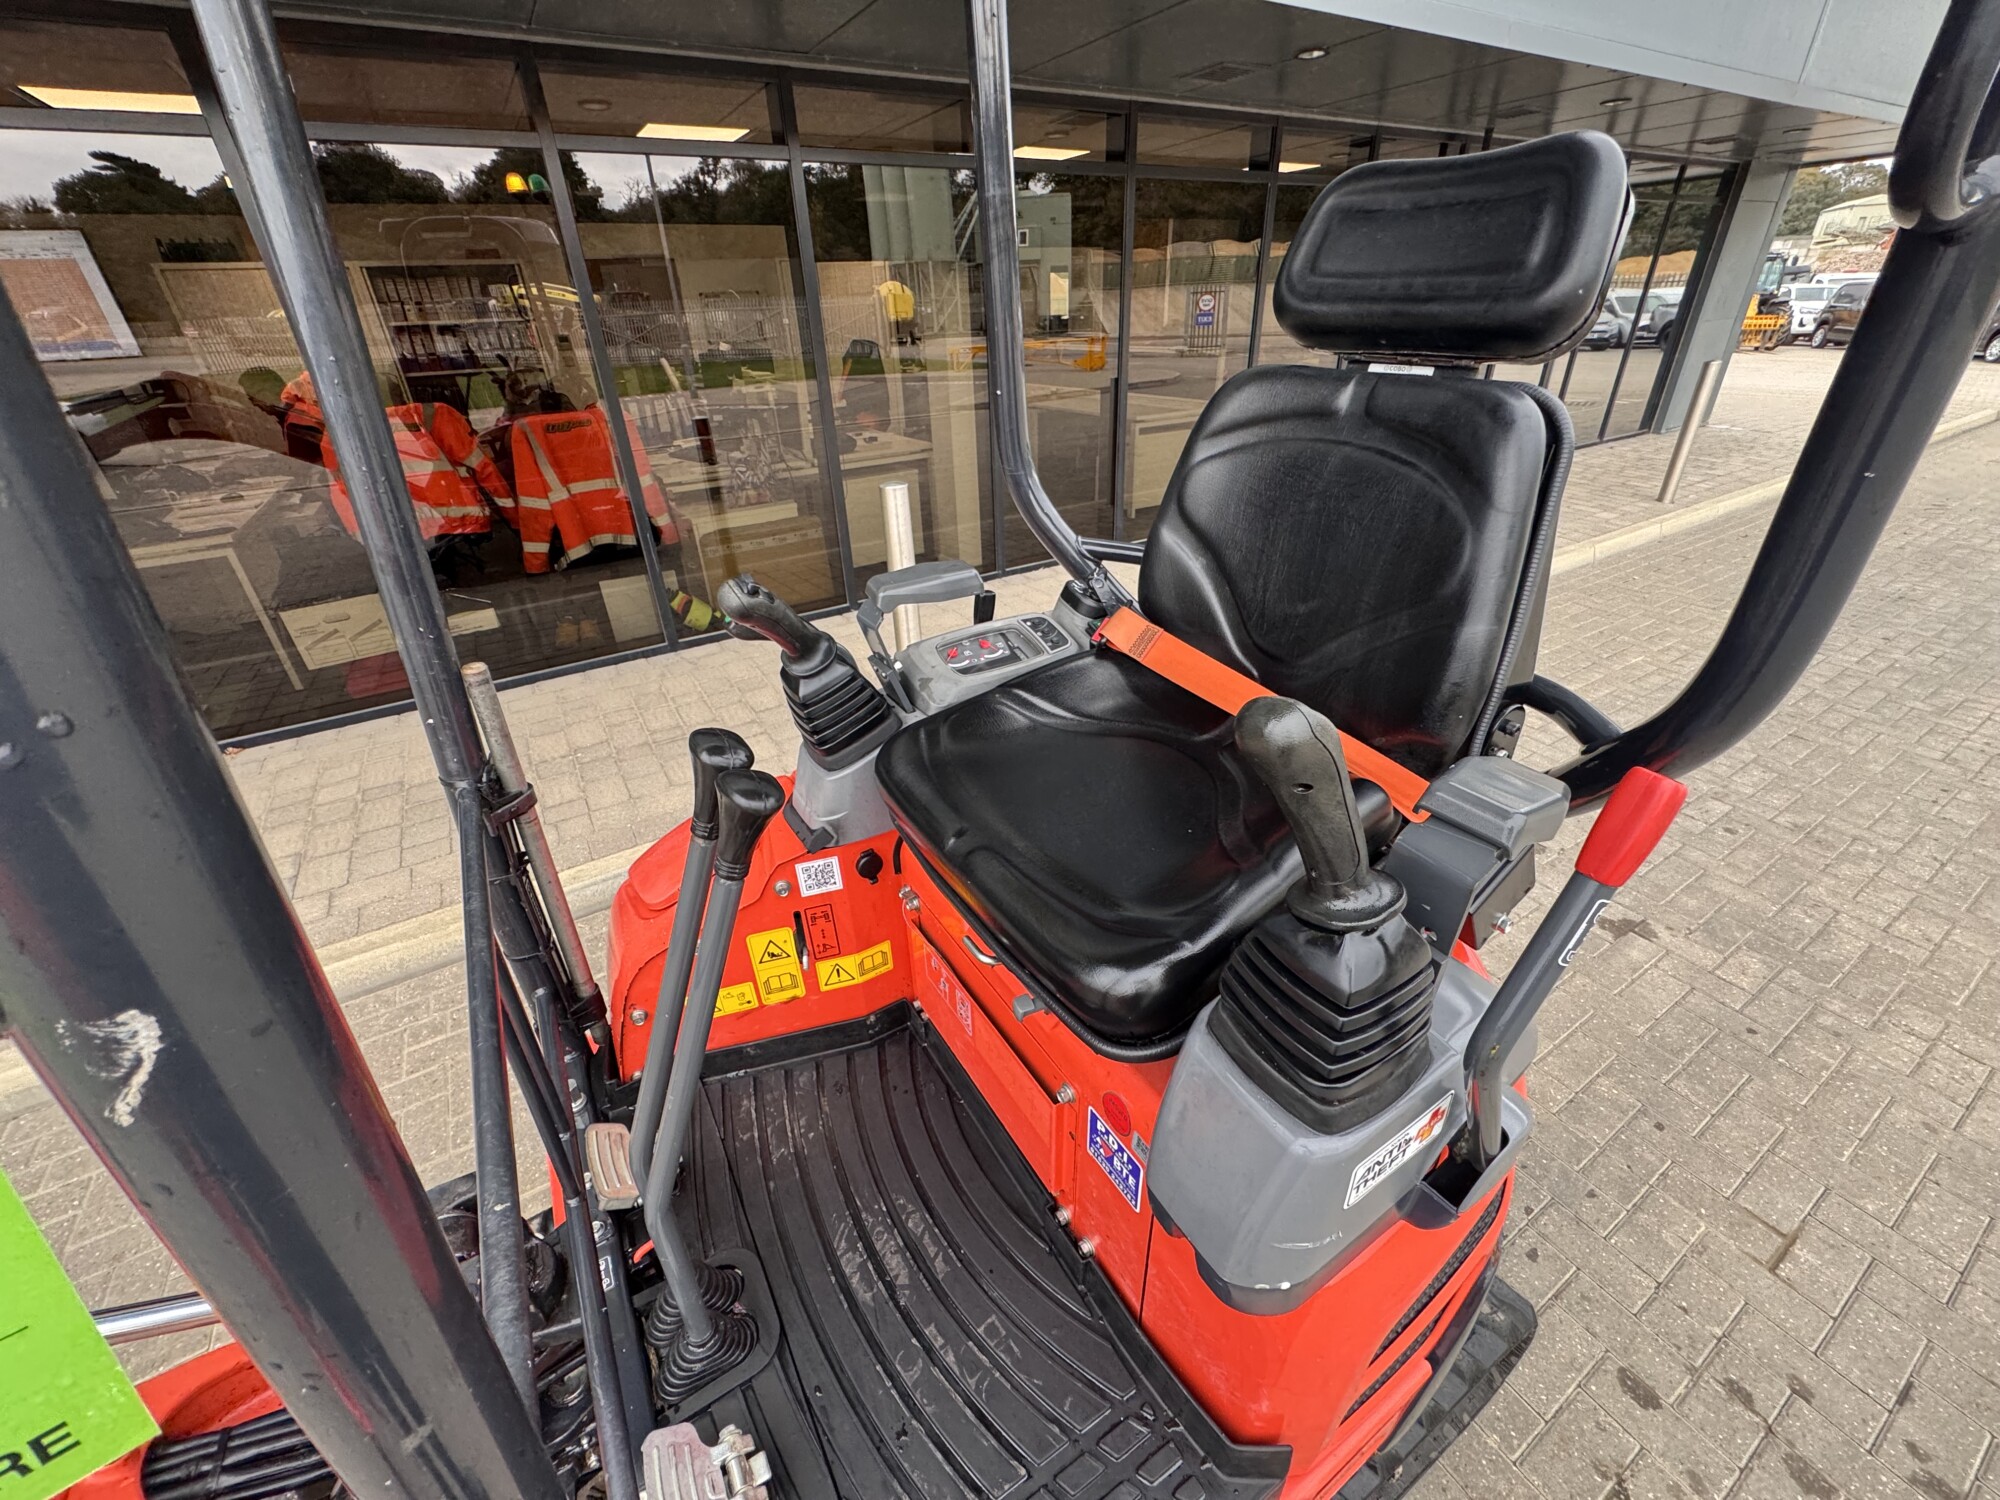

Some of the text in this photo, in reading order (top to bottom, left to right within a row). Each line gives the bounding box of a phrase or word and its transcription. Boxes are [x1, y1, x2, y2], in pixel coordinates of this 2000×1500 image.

[1113, 1155, 1137, 1190] BTE
[1352, 1143, 1412, 1194] THEFT
[1355, 1140, 1404, 1186] ANTI
